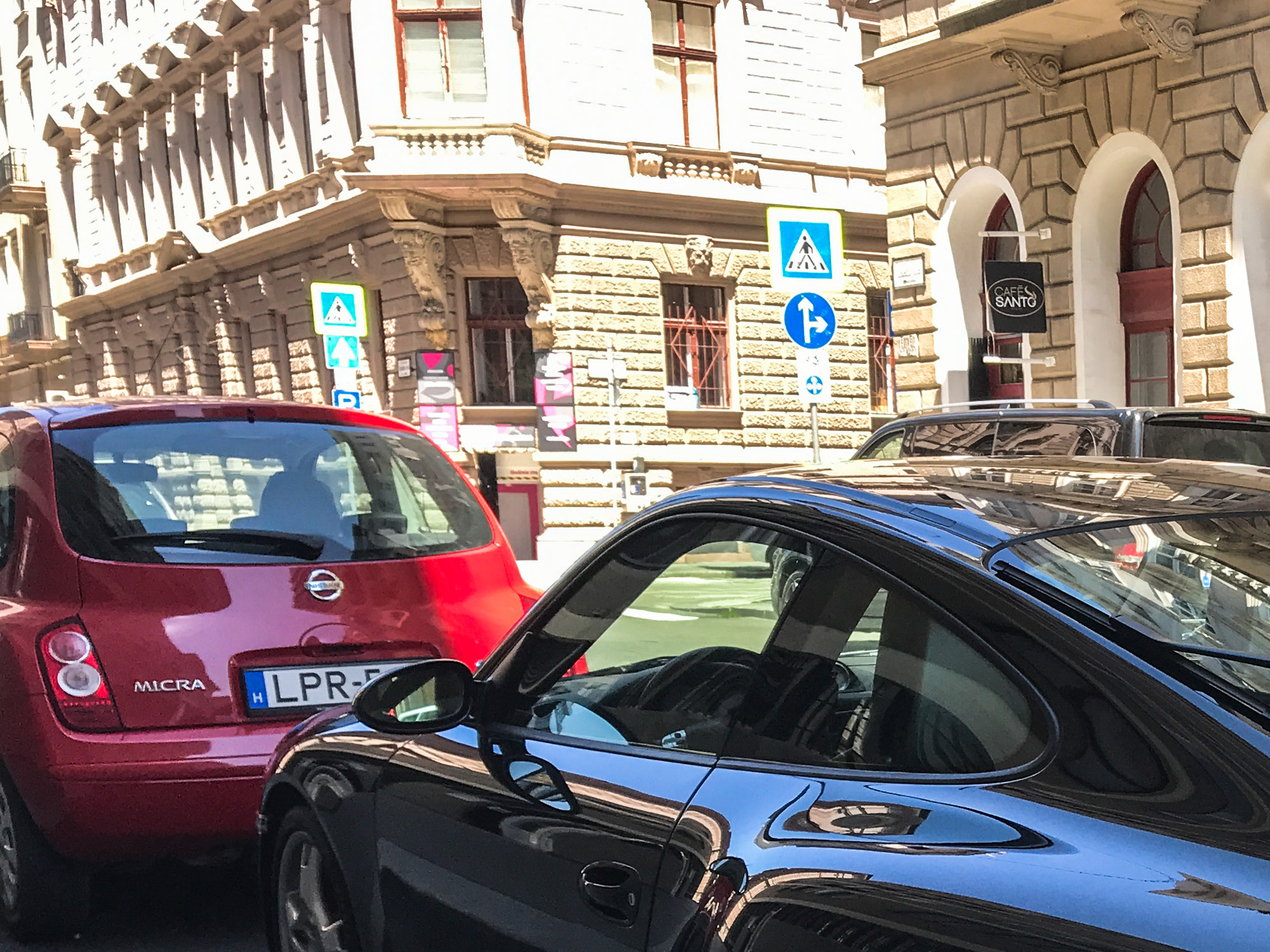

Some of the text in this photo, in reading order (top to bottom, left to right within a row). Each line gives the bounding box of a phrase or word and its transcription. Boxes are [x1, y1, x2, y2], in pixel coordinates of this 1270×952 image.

[995, 296, 1037, 308] SANTO
[338, 393, 357, 408] P
[133, 677, 206, 693] MICRA
[252, 692, 263, 704] H
